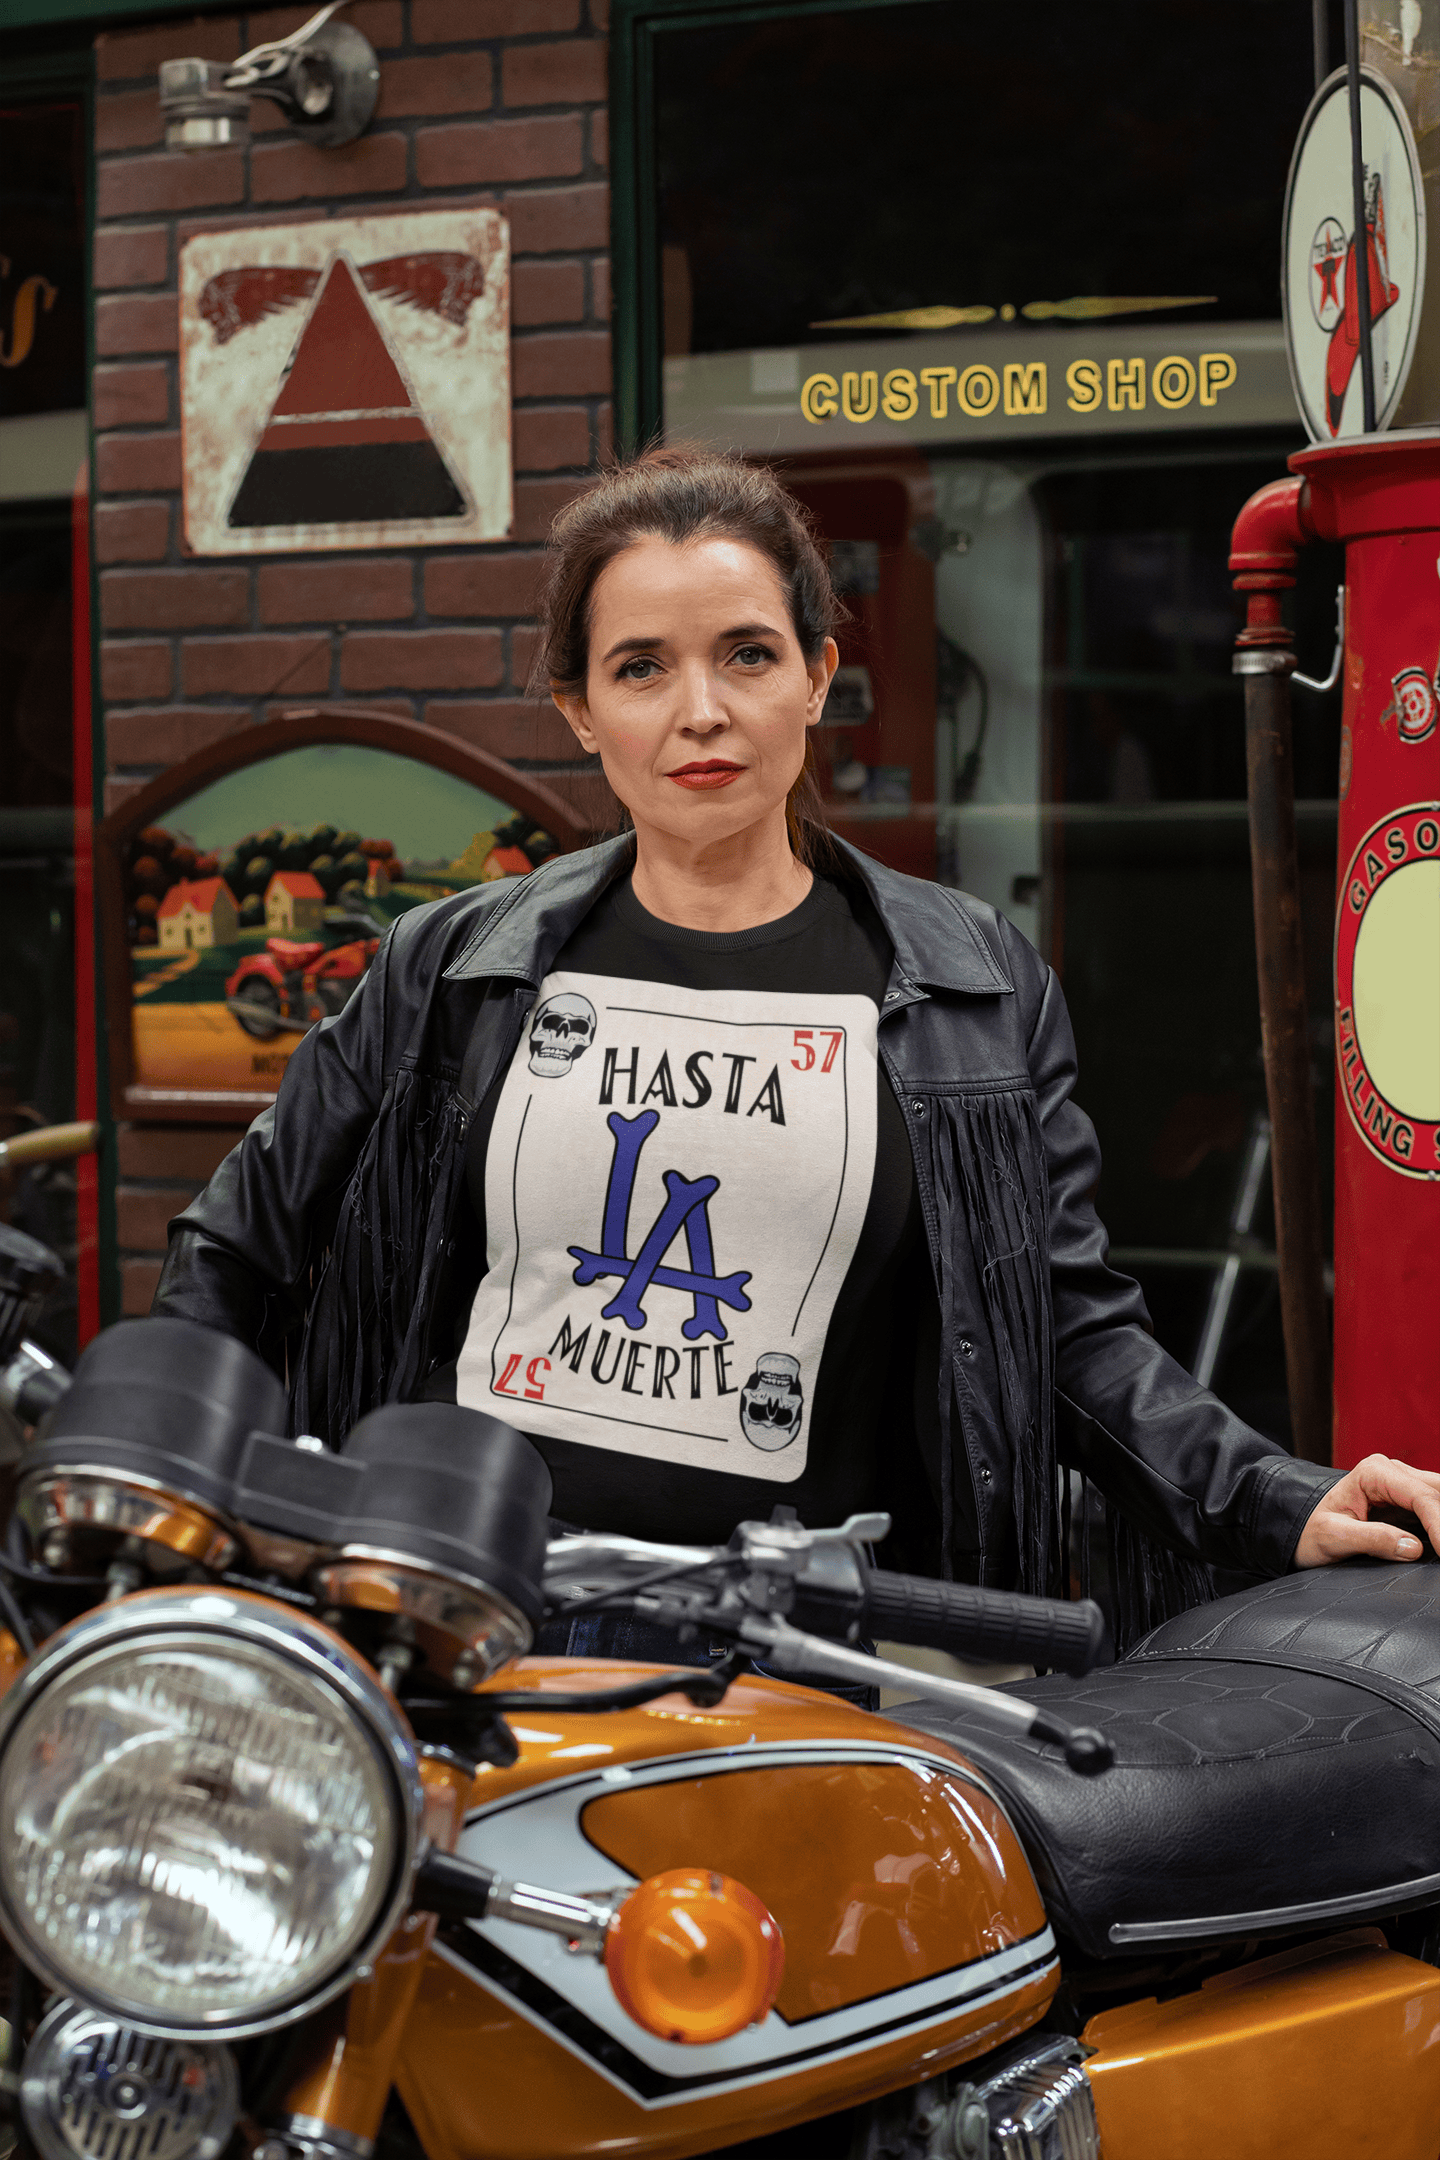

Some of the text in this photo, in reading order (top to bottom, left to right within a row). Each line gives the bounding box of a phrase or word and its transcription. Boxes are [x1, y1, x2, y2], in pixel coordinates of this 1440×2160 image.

[801, 353, 1237, 424] CUSTOM SHOP
[598, 1046, 786, 1126] HASTA
[791, 1030, 843, 1073] 57
[567, 1109, 752, 1341] LA
[493, 1354, 552, 1400] 57
[547, 1314, 739, 1400] MUERTE
